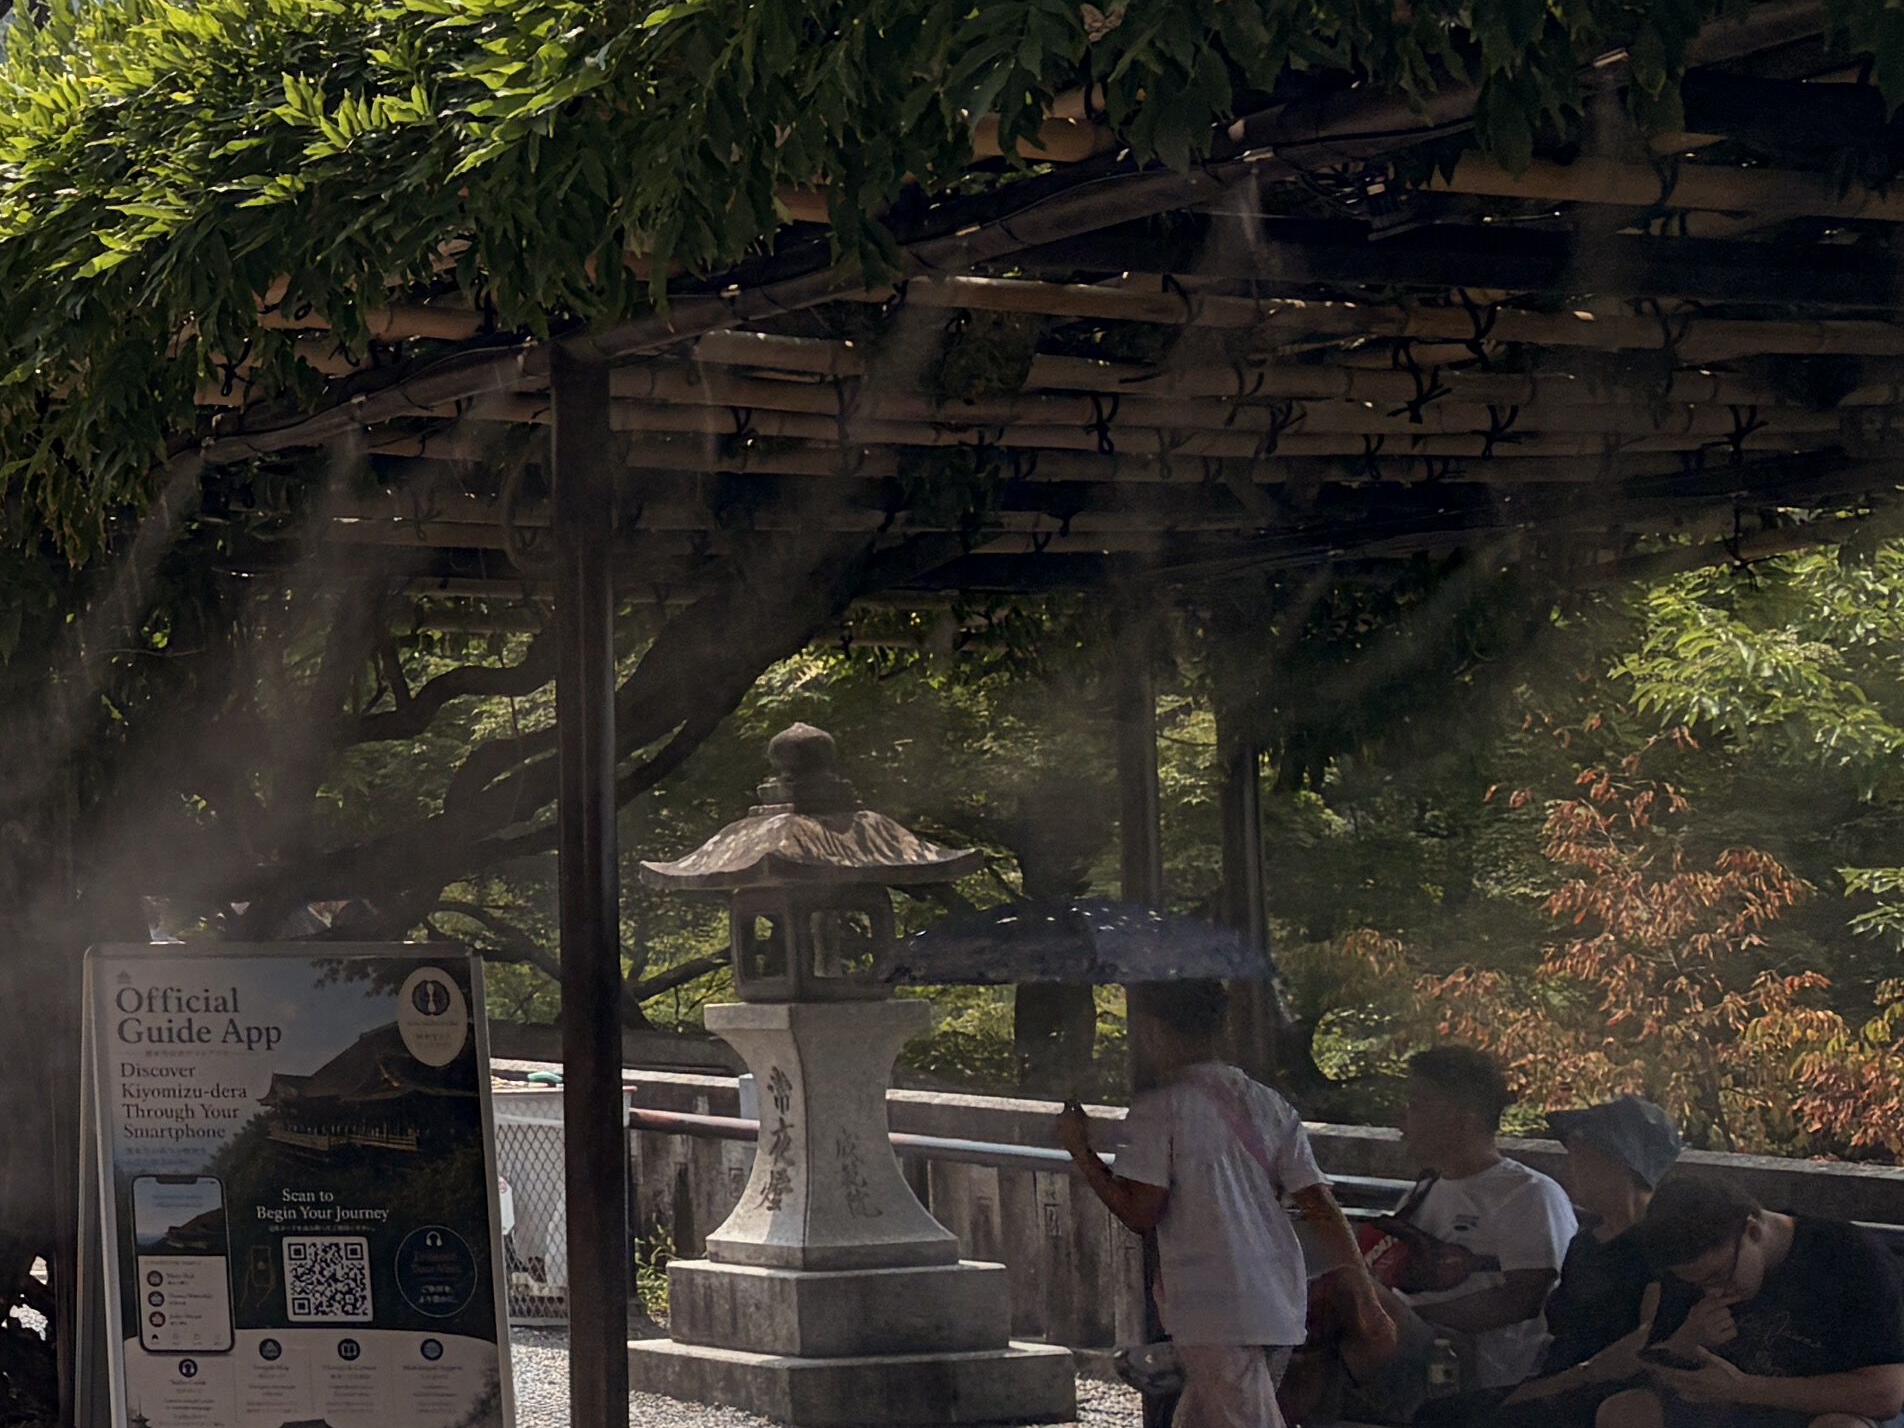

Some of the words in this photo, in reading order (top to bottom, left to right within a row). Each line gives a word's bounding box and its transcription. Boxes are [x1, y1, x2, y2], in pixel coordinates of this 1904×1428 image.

[115, 986, 241, 1014] Official
[117, 1017, 212, 1044] Guide
[221, 1018, 282, 1052] App
[120, 1062, 197, 1078] Discover
[121, 1083, 248, 1102] Kiyomizu-dera
[122, 1103, 195, 1122] Through
[201, 1104, 241, 1120] Your
[123, 1123, 227, 1142] Smartphone
[281, 1188, 315, 1203] Scan
[319, 1189, 334, 1203] to
[256, 1205, 297, 1222] Begin
[300, 1205, 333, 1220] Your
[335, 1205, 390, 1222] Journey
